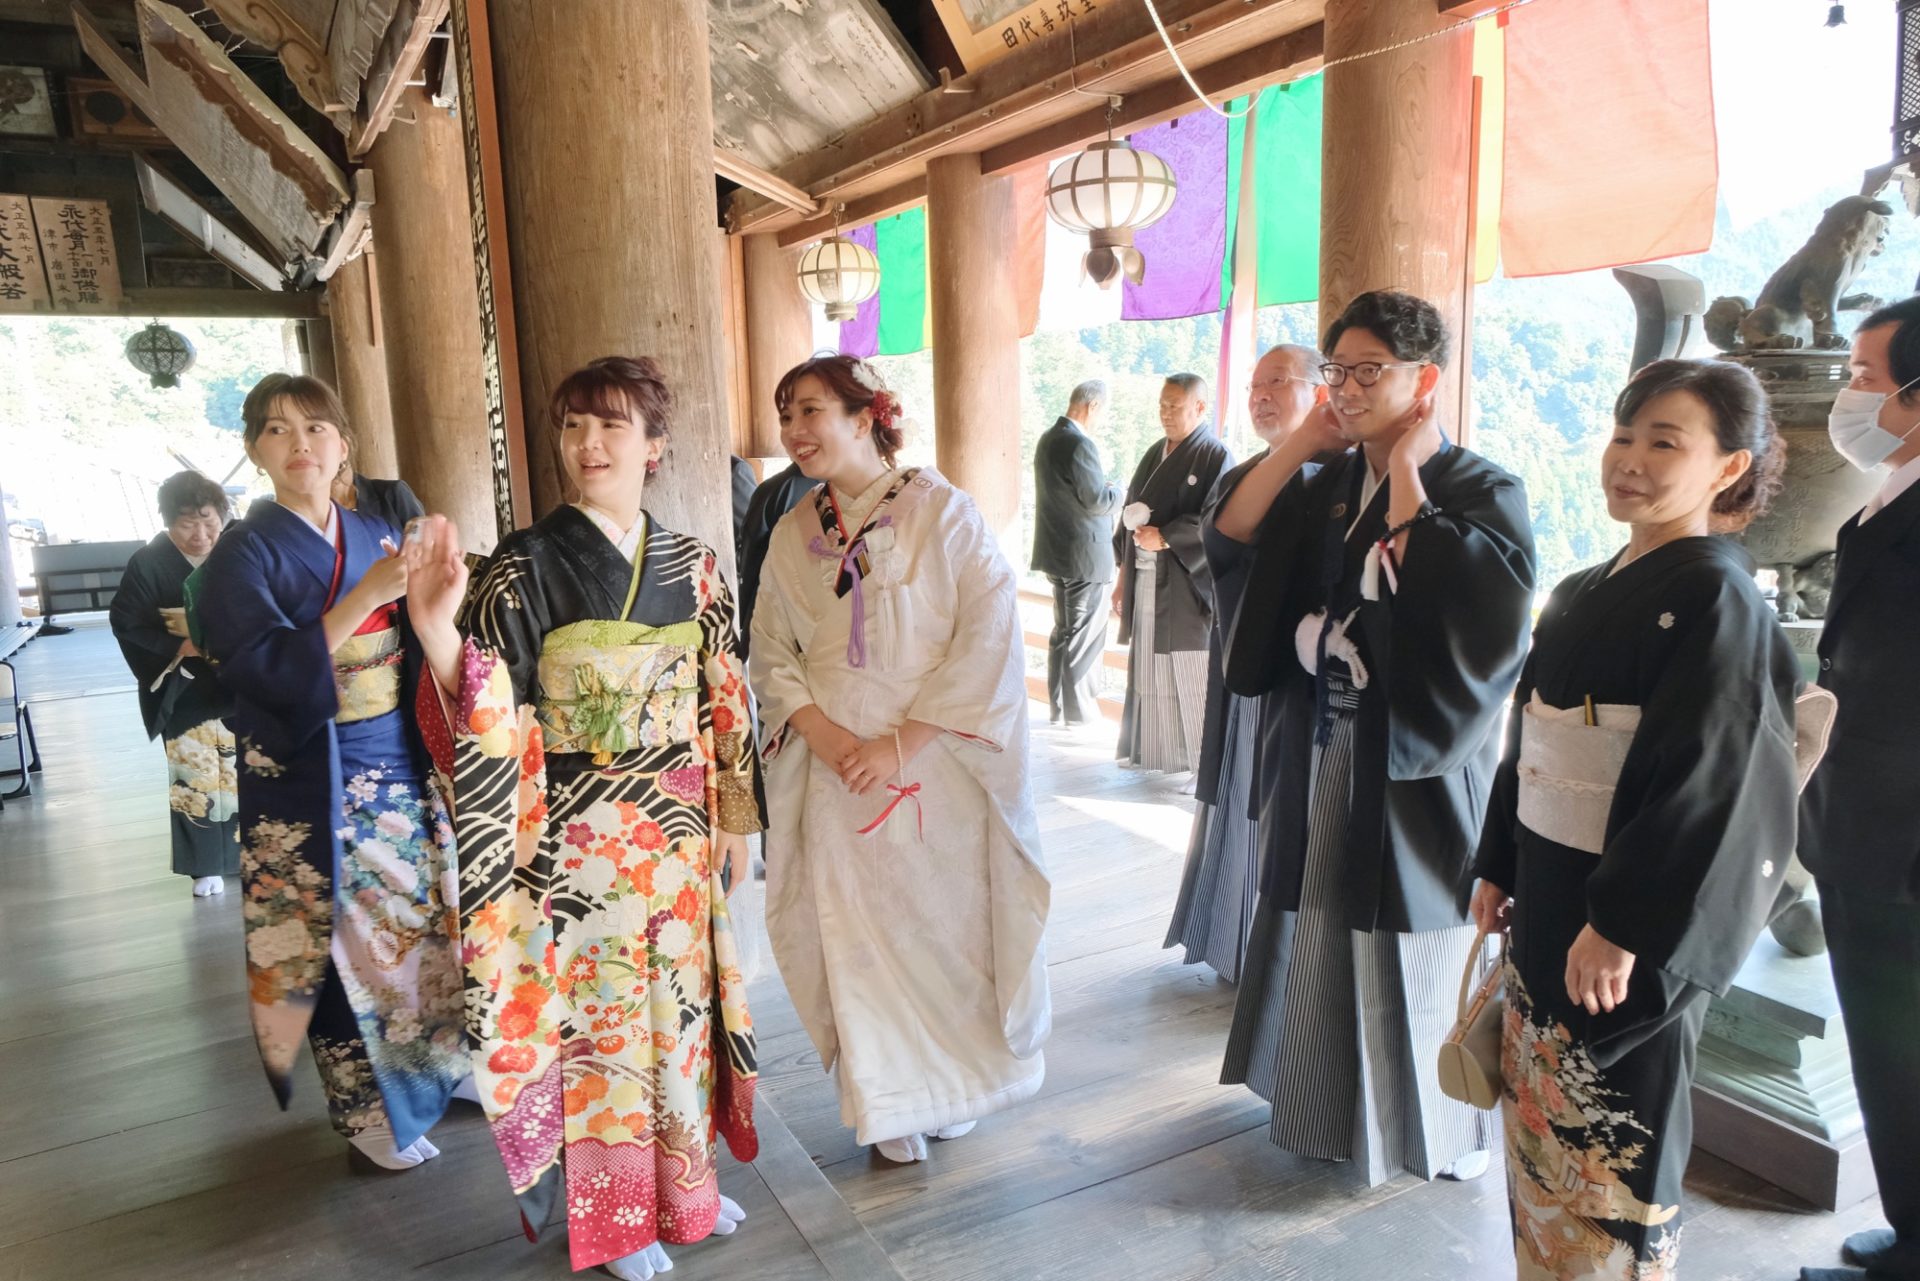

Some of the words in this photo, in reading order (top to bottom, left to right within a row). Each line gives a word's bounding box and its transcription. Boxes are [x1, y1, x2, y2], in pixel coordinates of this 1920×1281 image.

[10, 201, 35, 264] 大正五年七月
[89, 206, 111, 266] 大正五年七月
